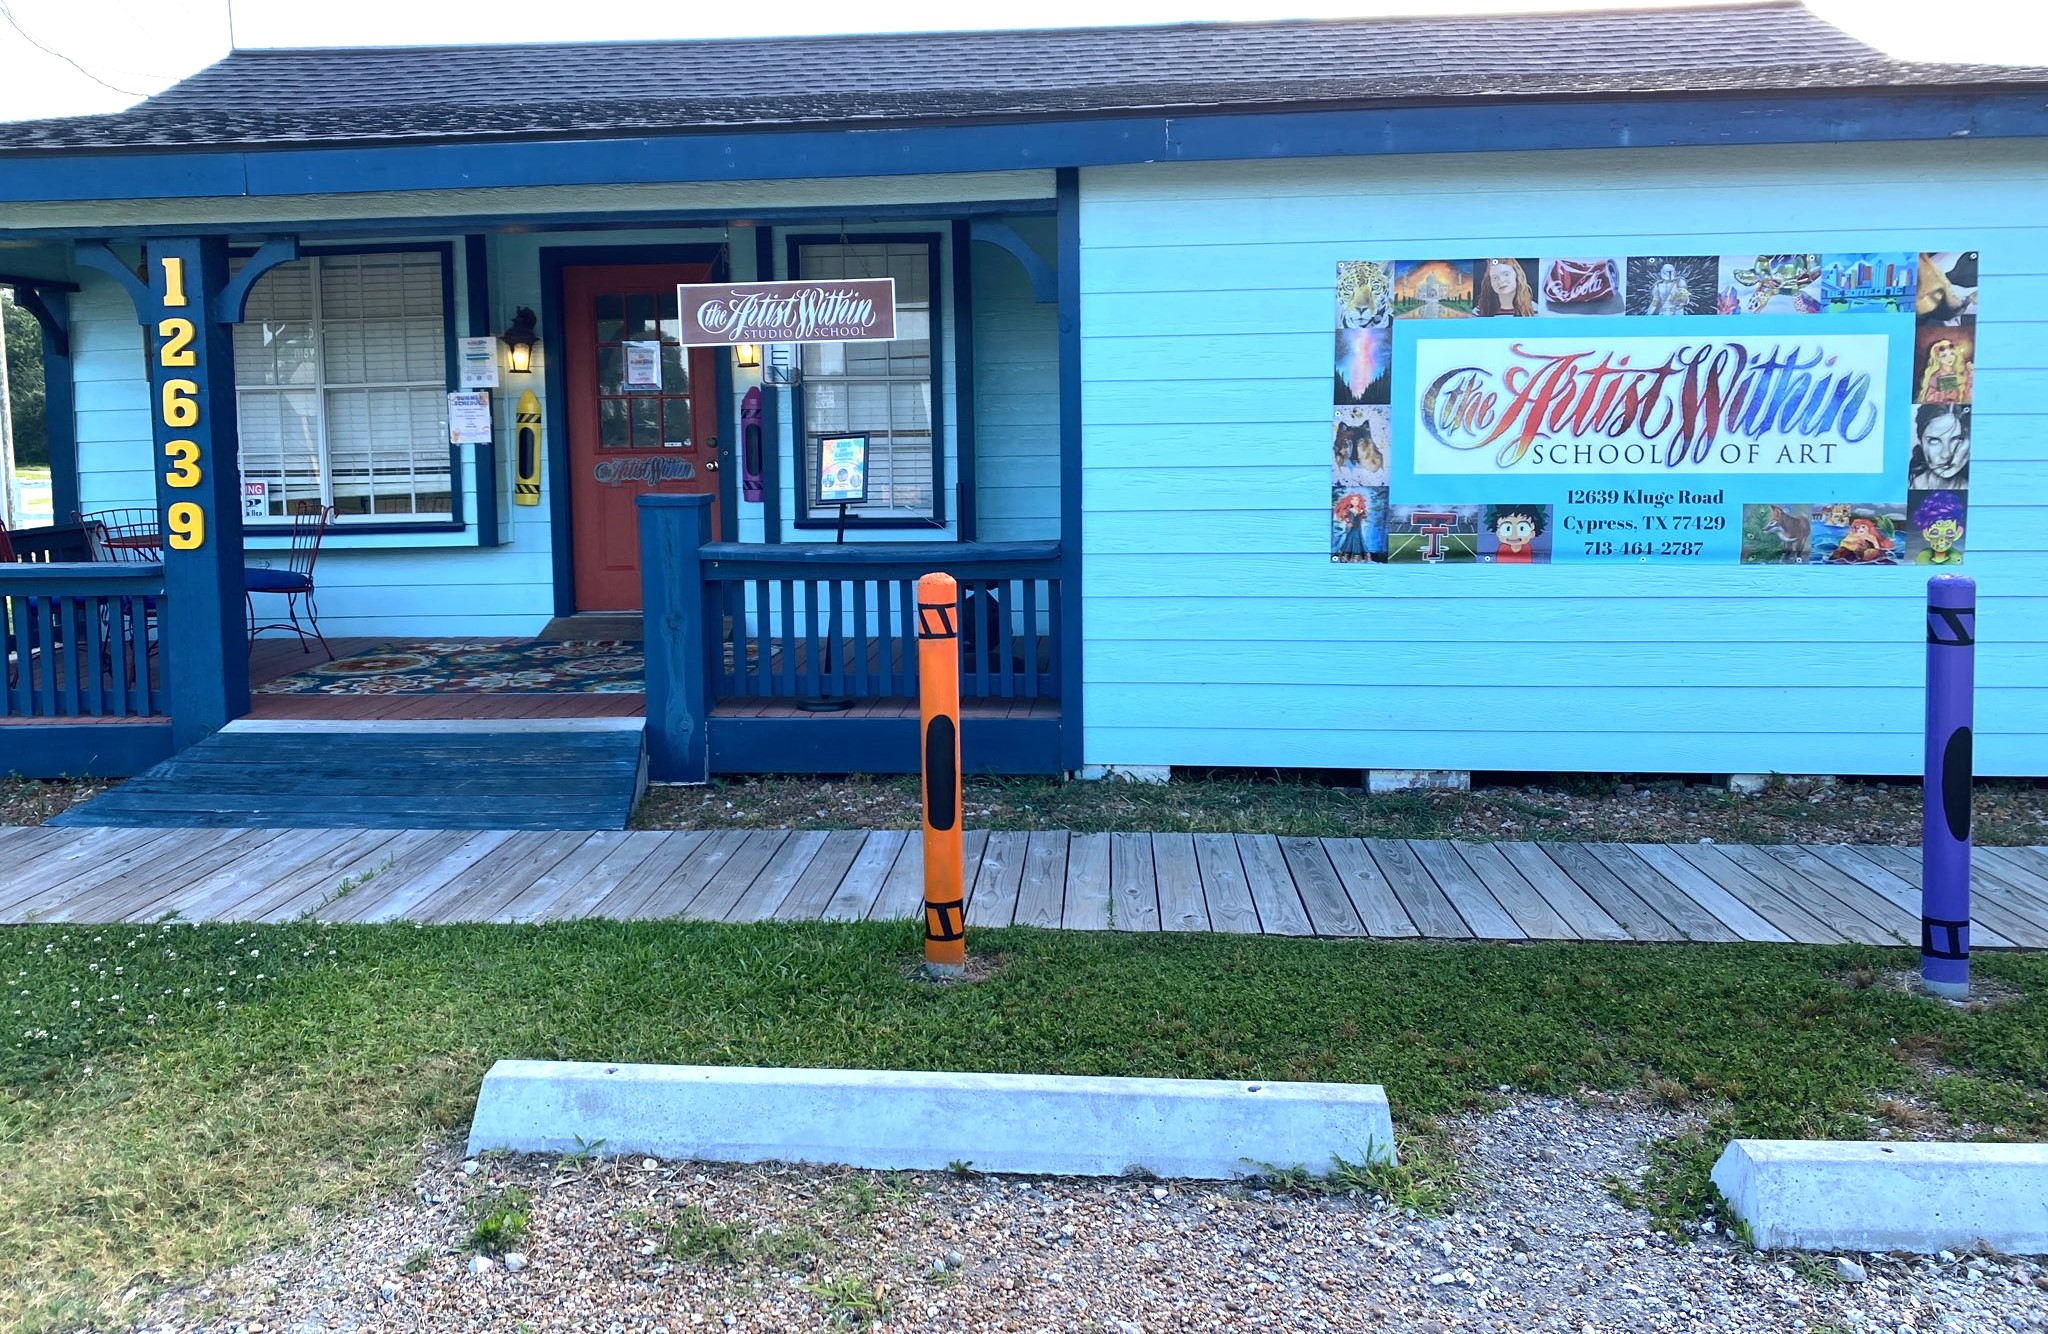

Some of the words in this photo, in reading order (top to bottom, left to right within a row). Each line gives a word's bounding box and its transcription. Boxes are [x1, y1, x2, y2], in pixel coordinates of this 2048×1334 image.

[697, 300, 730, 334] the
[729, 290, 797, 340] Artist
[795, 287, 876, 339] Within
[744, 329, 793, 340] STUDIO
[814, 327, 867, 338] SCHOOL
[158, 257, 204, 550] 12639
[1421, 367, 1498, 450] the
[1496, 343, 1684, 468] Artist
[1665, 342, 1878, 468] Within
[1532, 444, 1664, 465] SCHOOL
[1720, 443, 1760, 464] OF
[1776, 443, 1837, 464] ART
[1567, 489, 1619, 504] 12639
[1623, 489, 1675, 509] Kluge
[1678, 489, 1724, 504] Road
[1563, 515, 1638, 534] Cypress,
[1642, 515, 1668, 530] TX
[1672, 515, 1726, 530] 77429
[1584, 541, 1704, 556] 713-464-2787
